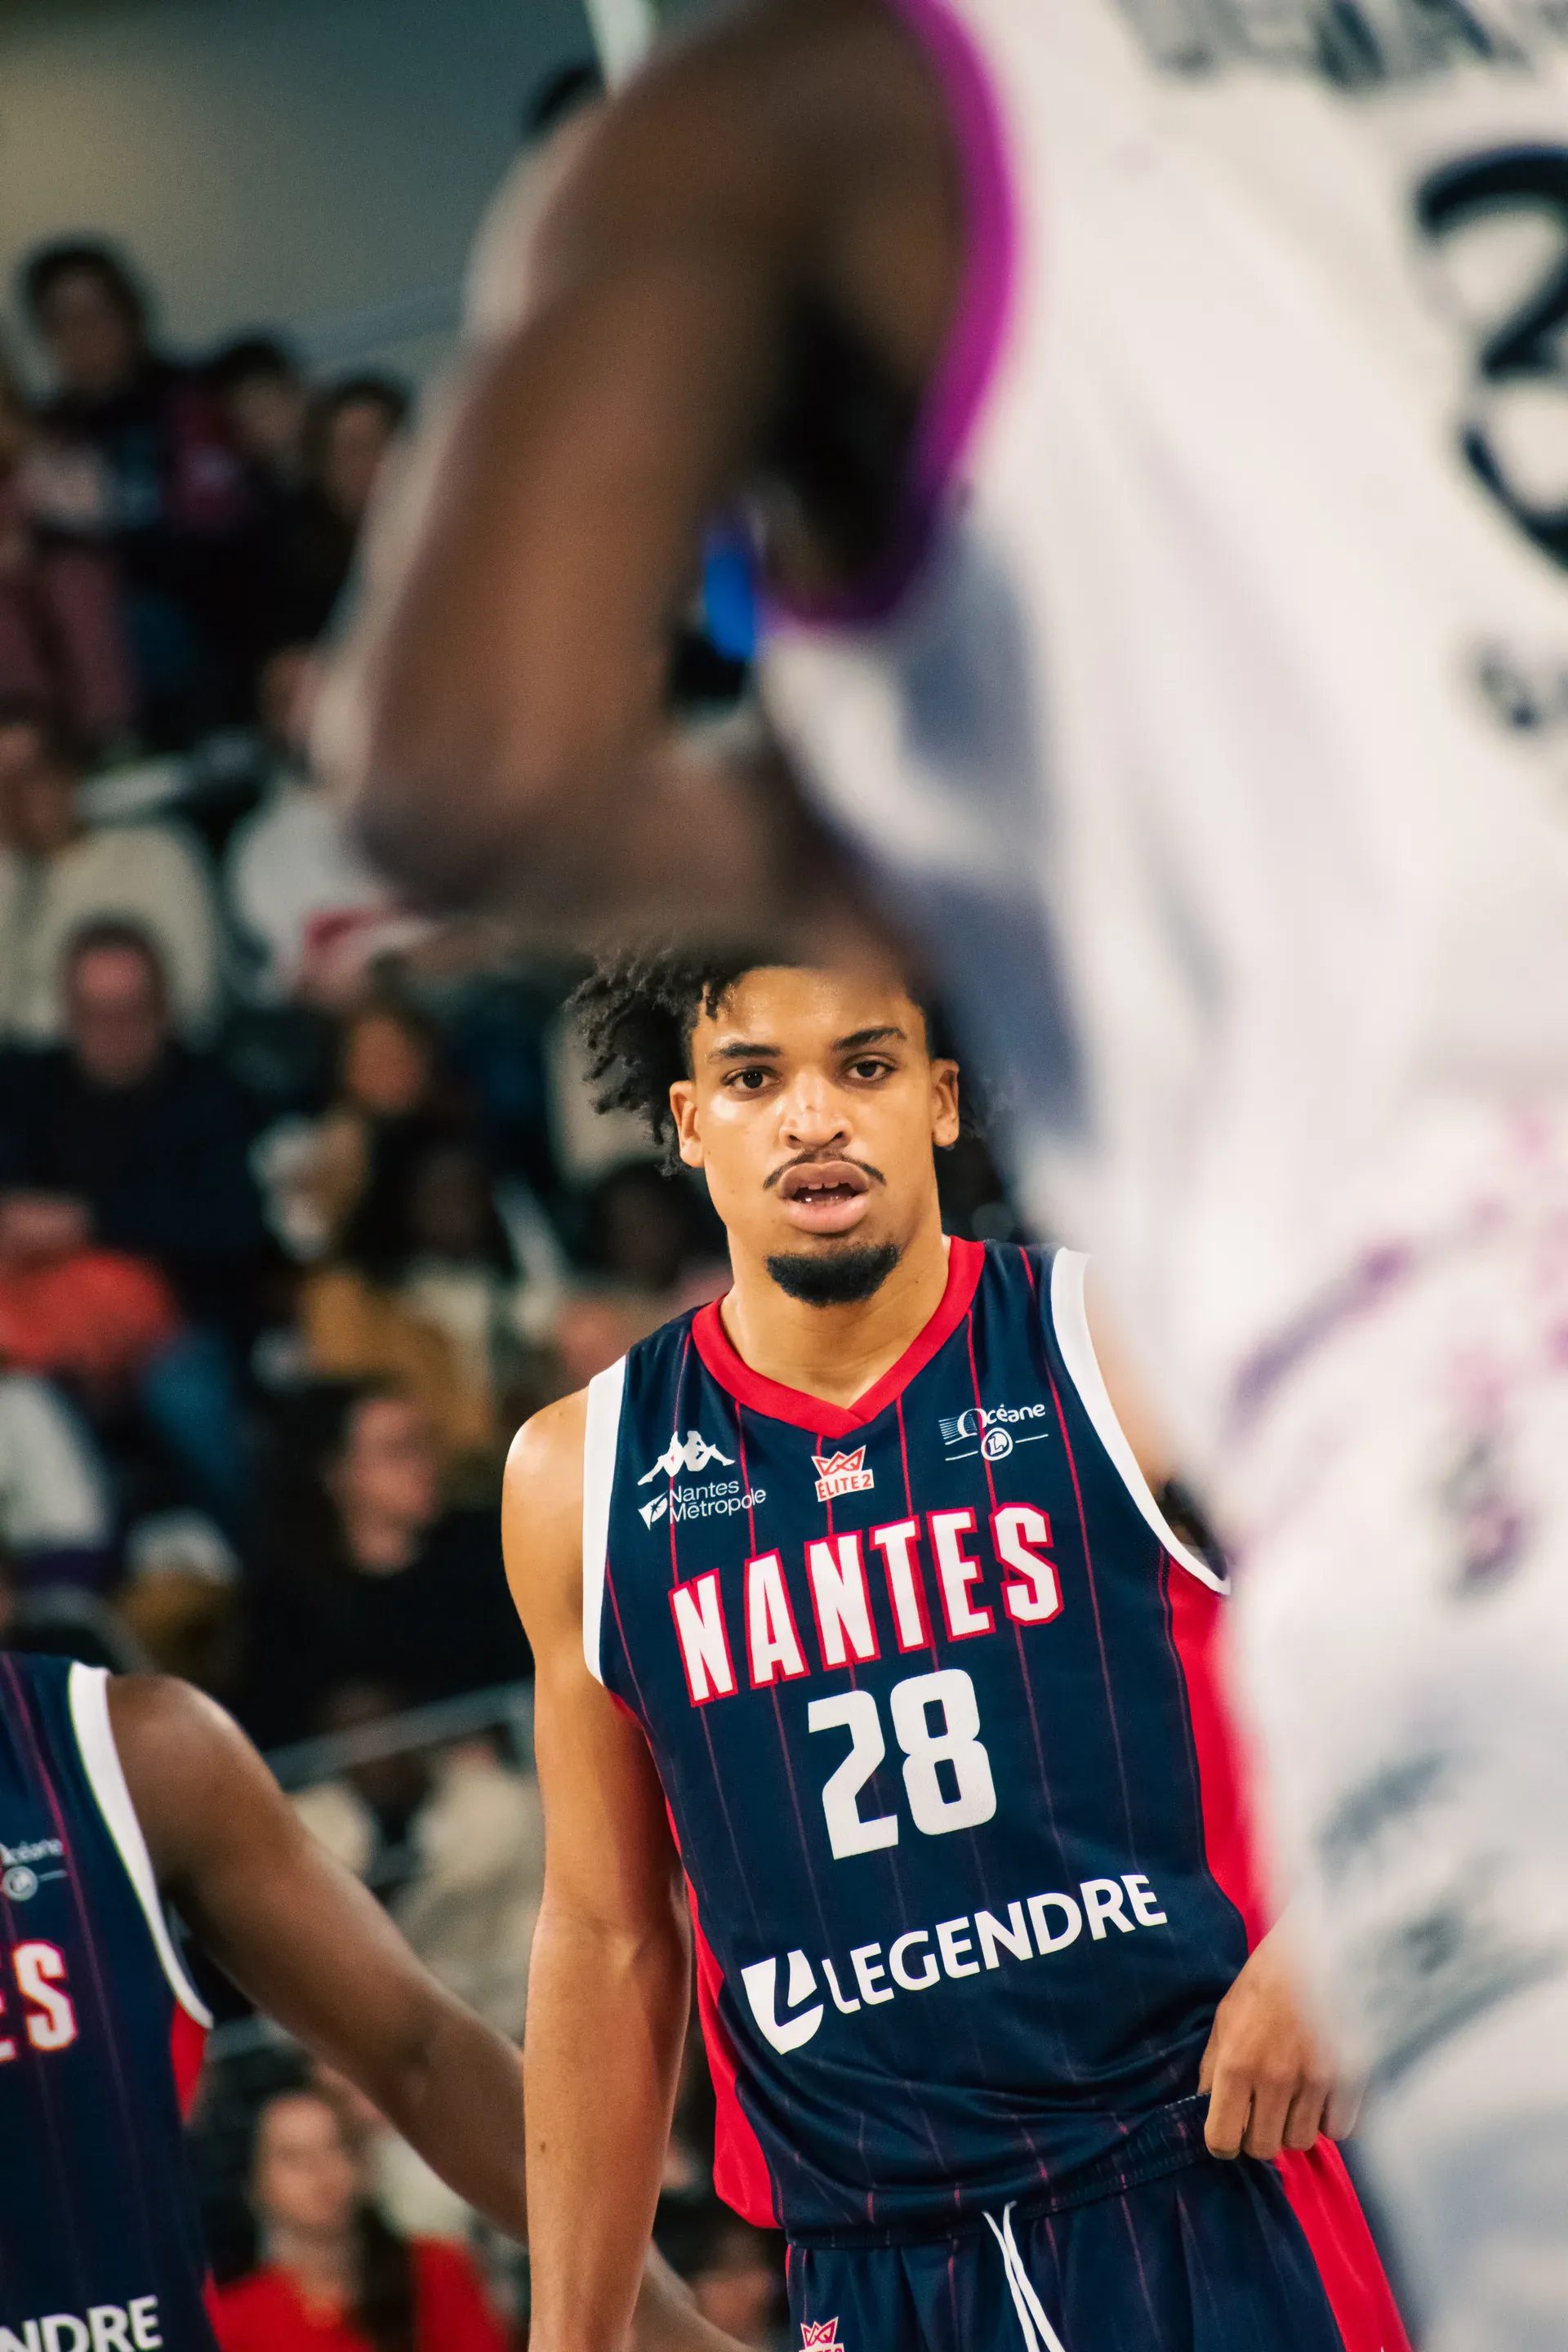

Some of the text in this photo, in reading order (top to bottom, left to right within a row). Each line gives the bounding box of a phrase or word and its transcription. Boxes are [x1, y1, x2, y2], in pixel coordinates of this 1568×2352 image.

[957, 1404, 1045, 1437] Océane
[670, 1481, 739, 1503] Nantes
[670, 1488, 766, 1524] Métropole
[668, 1502, 1064, 1708] NANTES
[808, 1668, 997, 1860] 28
[822, 1874, 1167, 2014] LEGENDRE
